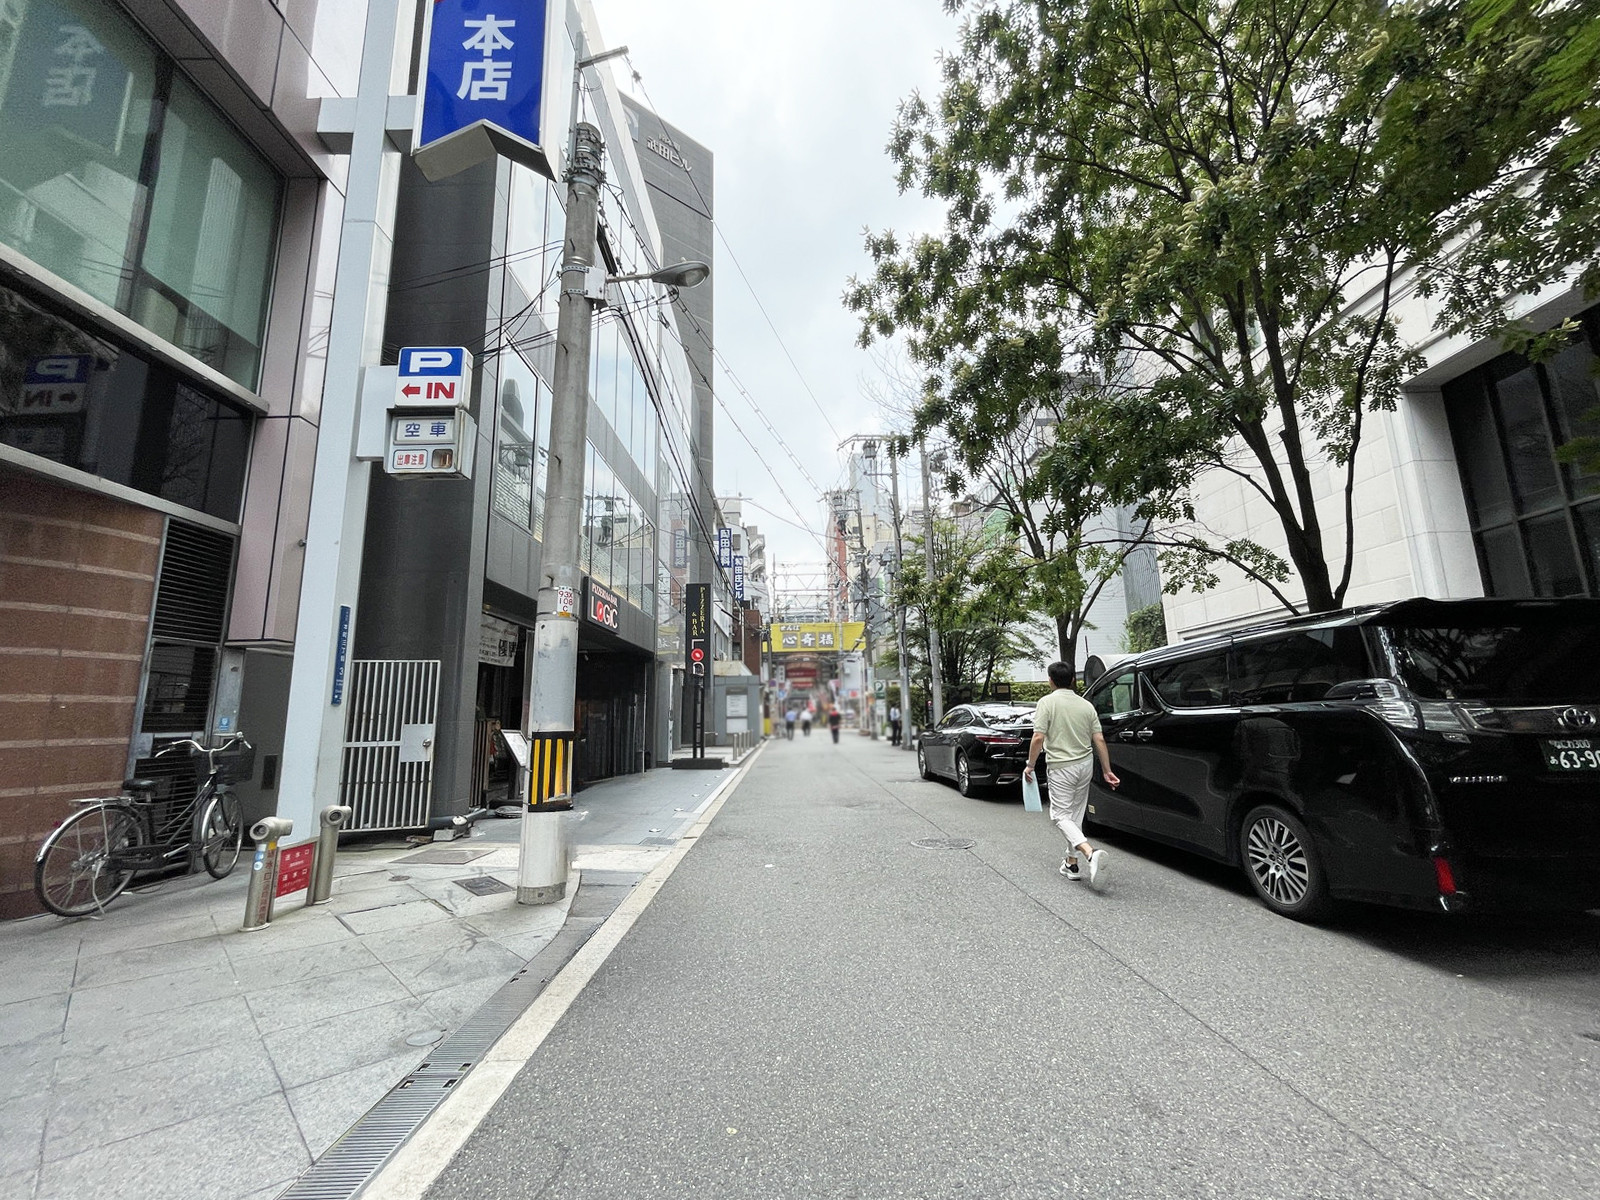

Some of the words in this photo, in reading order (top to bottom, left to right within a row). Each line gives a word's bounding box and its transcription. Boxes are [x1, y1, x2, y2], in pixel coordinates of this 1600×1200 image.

[456, 14, 516, 101] 本店
[409, 351, 453, 373] P
[426, 382, 455, 399] IN
[404, 422, 447, 437] 空車
[559, 598, 574, 606] 108
